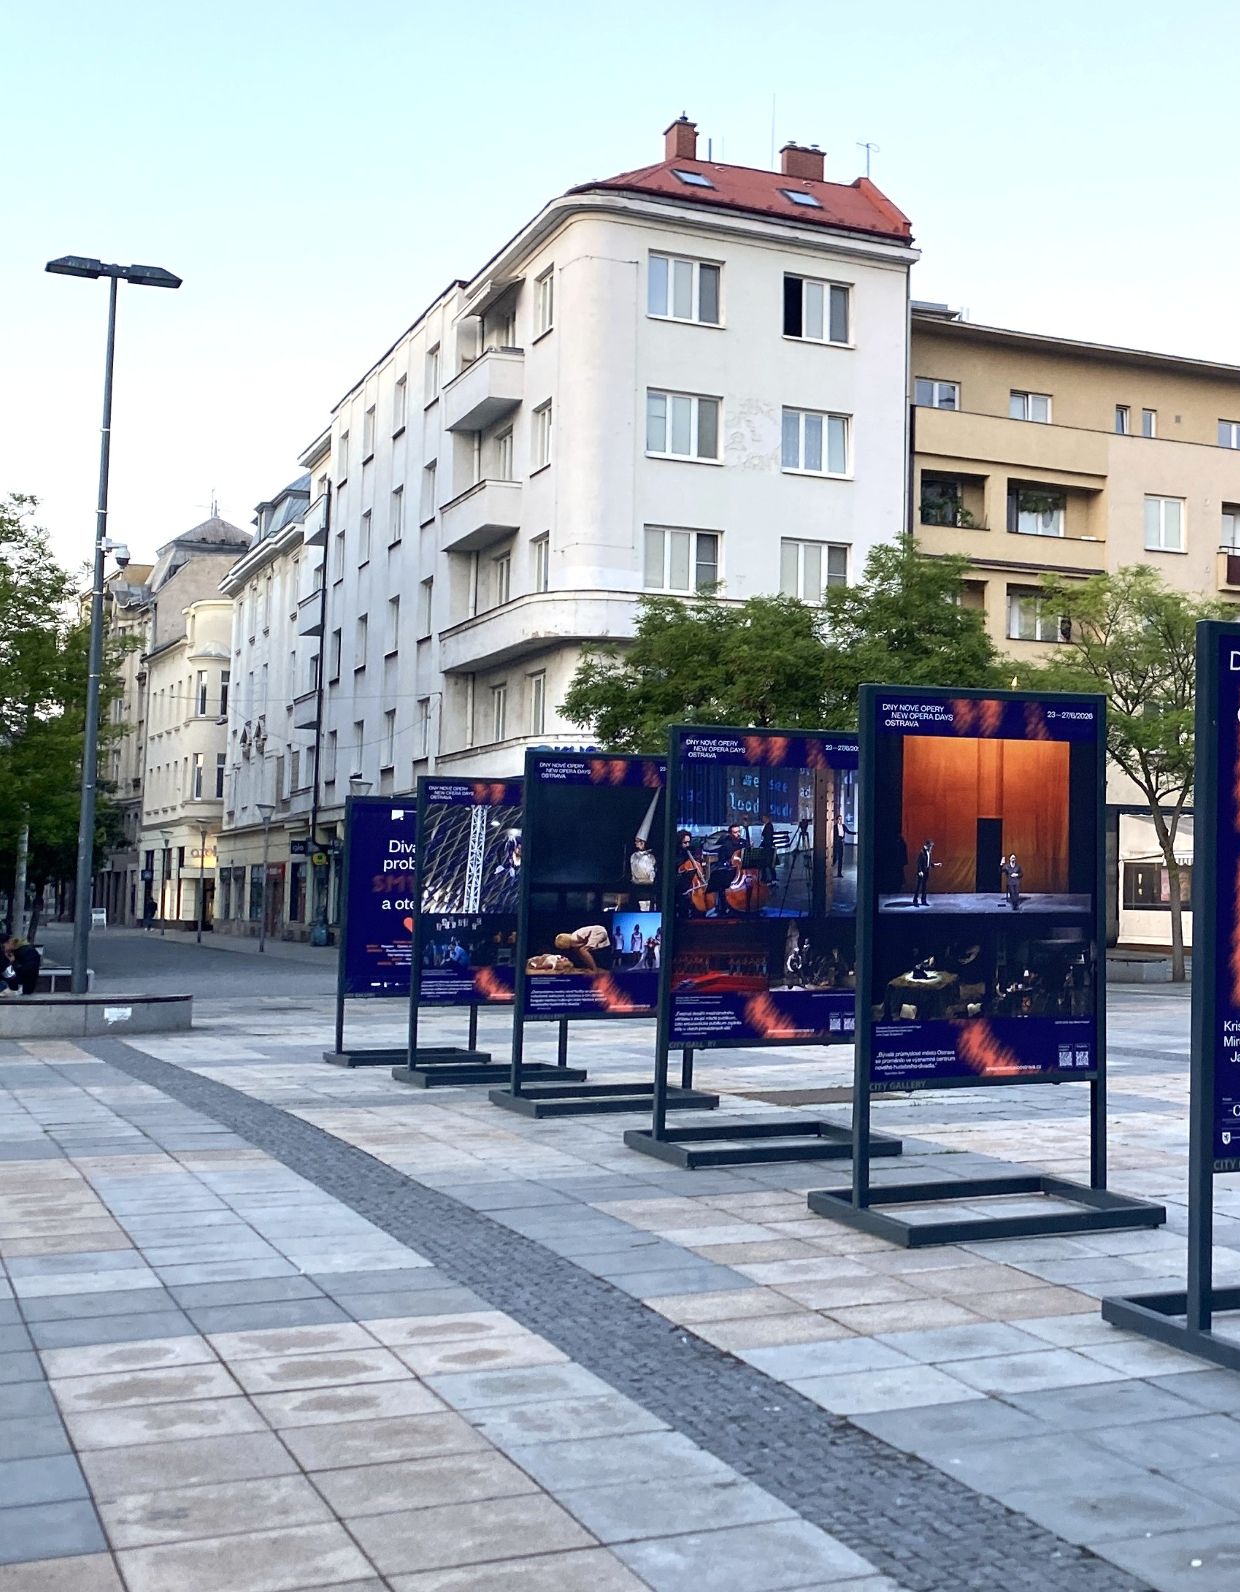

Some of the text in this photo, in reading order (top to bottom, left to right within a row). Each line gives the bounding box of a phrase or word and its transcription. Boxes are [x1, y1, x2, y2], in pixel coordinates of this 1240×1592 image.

[921, 705, 944, 713] OPERY
[909, 712, 934, 720] OPERA
[935, 713, 954, 722] DAYS
[382, 899, 391, 910] a
[869, 1082, 887, 1091] CITY
[1213, 1158, 1236, 1171] CITY
